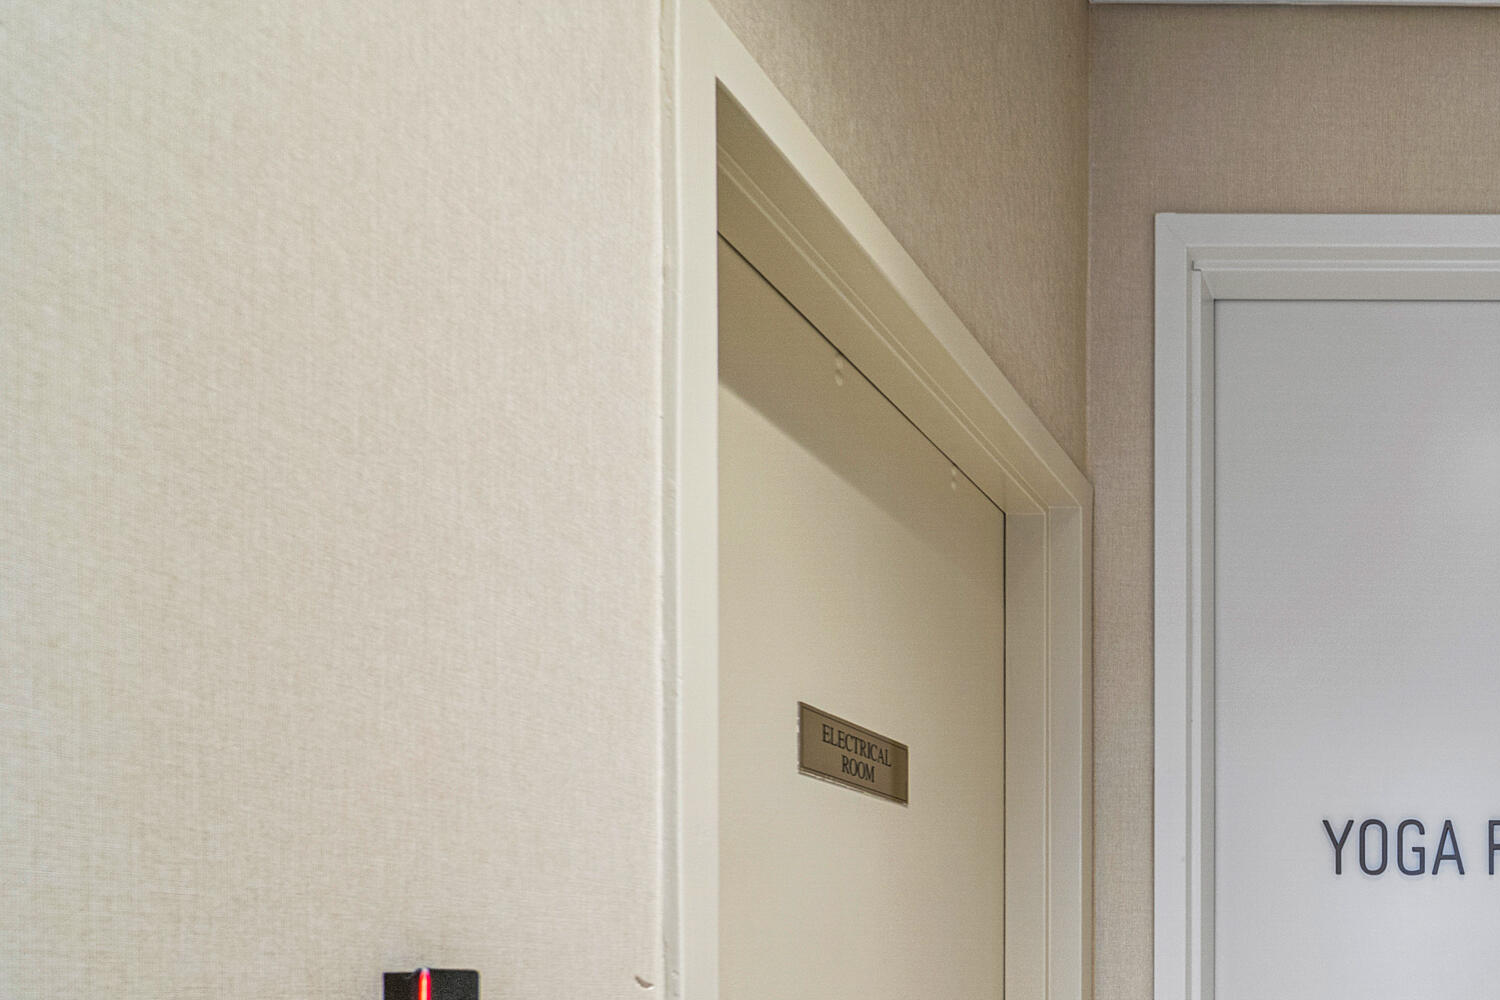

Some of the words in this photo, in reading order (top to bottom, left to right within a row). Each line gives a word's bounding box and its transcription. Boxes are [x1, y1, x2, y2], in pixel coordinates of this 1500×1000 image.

[823, 723, 892, 767] ELECTRICAL
[841, 754, 875, 783] ROOM
[1322, 819, 1465, 876] YOGA
